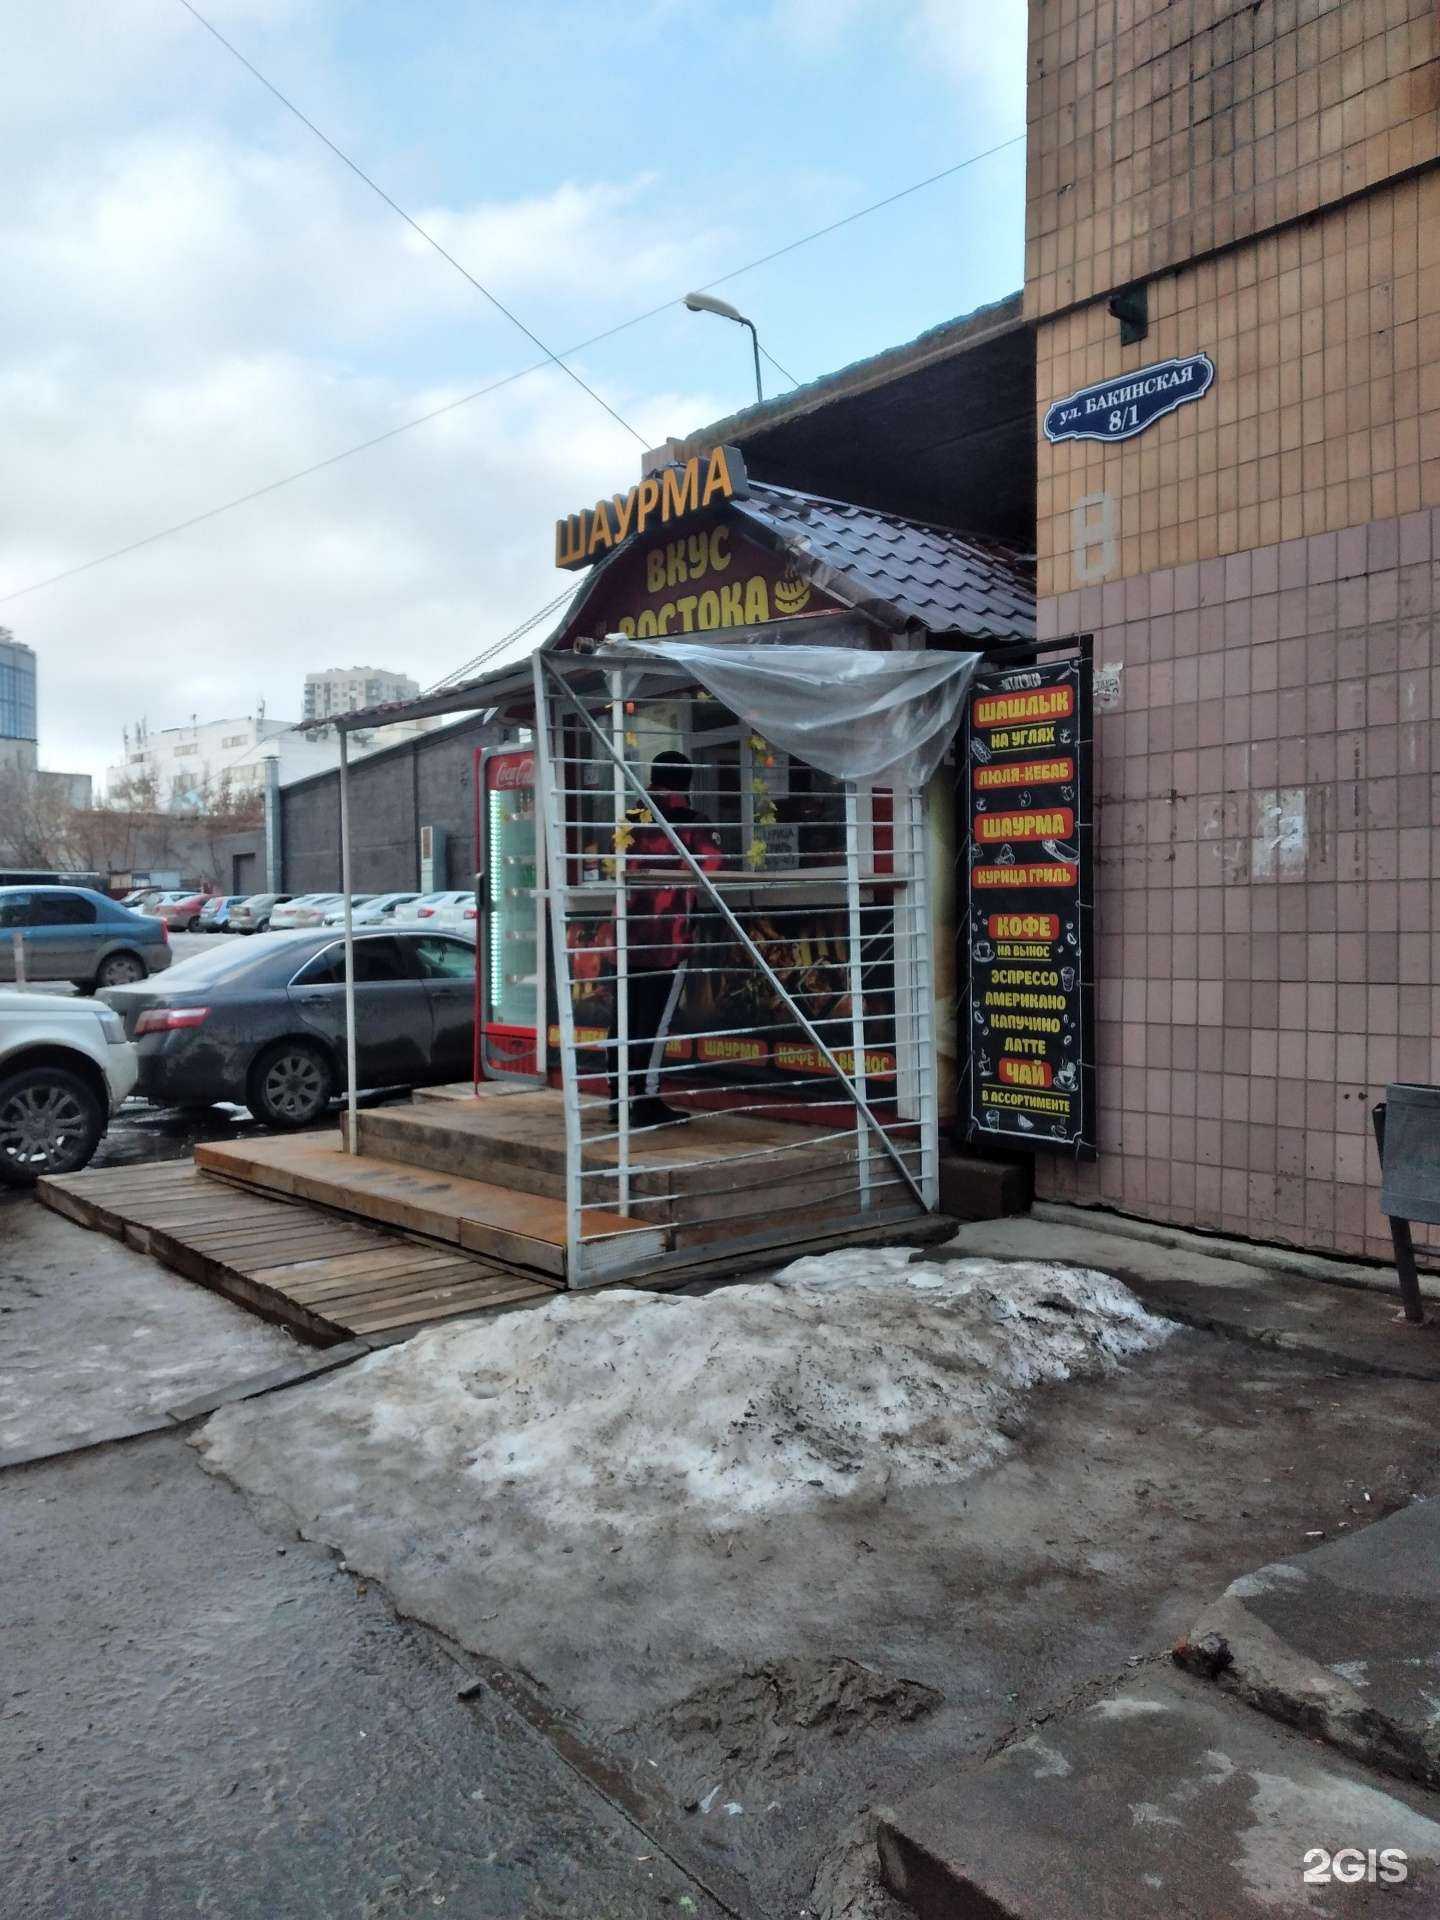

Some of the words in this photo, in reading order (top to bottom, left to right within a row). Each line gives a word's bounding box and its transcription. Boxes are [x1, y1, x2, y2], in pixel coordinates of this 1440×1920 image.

[1059, 407, 1081, 426] ул.
[1086, 366, 1194, 415] БАКИНСКАЯ
[1109, 405, 1139, 432] 8/1
[555, 446, 733, 568] ШАУРМА
[647, 525, 731, 593] ВКУС
[618, 575, 769, 639] ВОСТОКА
[979, 691, 1069, 722] ШАШЛЫК
[991, 733, 1009, 748] НА
[1012, 727, 1055, 746] УГЛЯХ
[979, 762, 1069, 785] ЛЮЛЯ-КЕБАБ
[983, 813, 1064, 838] ШАУРМА
[977, 869, 1027, 885] КУРИЦА
[1029, 868, 1071, 883] ГРИЛЬ
[997, 916, 1051, 938] КОФЕ
[998, 945, 1009, 957] НА
[1011, 945, 1050, 958] ВЫНОС
[991, 969, 1059, 987] ЭСПРЕССО
[985, 992, 1066, 1010] АМЕРИКАНО
[990, 1014, 1061, 1033] КАПУЧИНО
[704, 1039, 760, 1058] ШАУРМА
[1004, 1038, 1046, 1055] ЛАТТЕ
[1006, 1059, 1045, 1086] ЧАЙ
[982, 1090, 989, 1101] В
[991, 1091, 1070, 1112] АССОРТИМЕНТЕ
